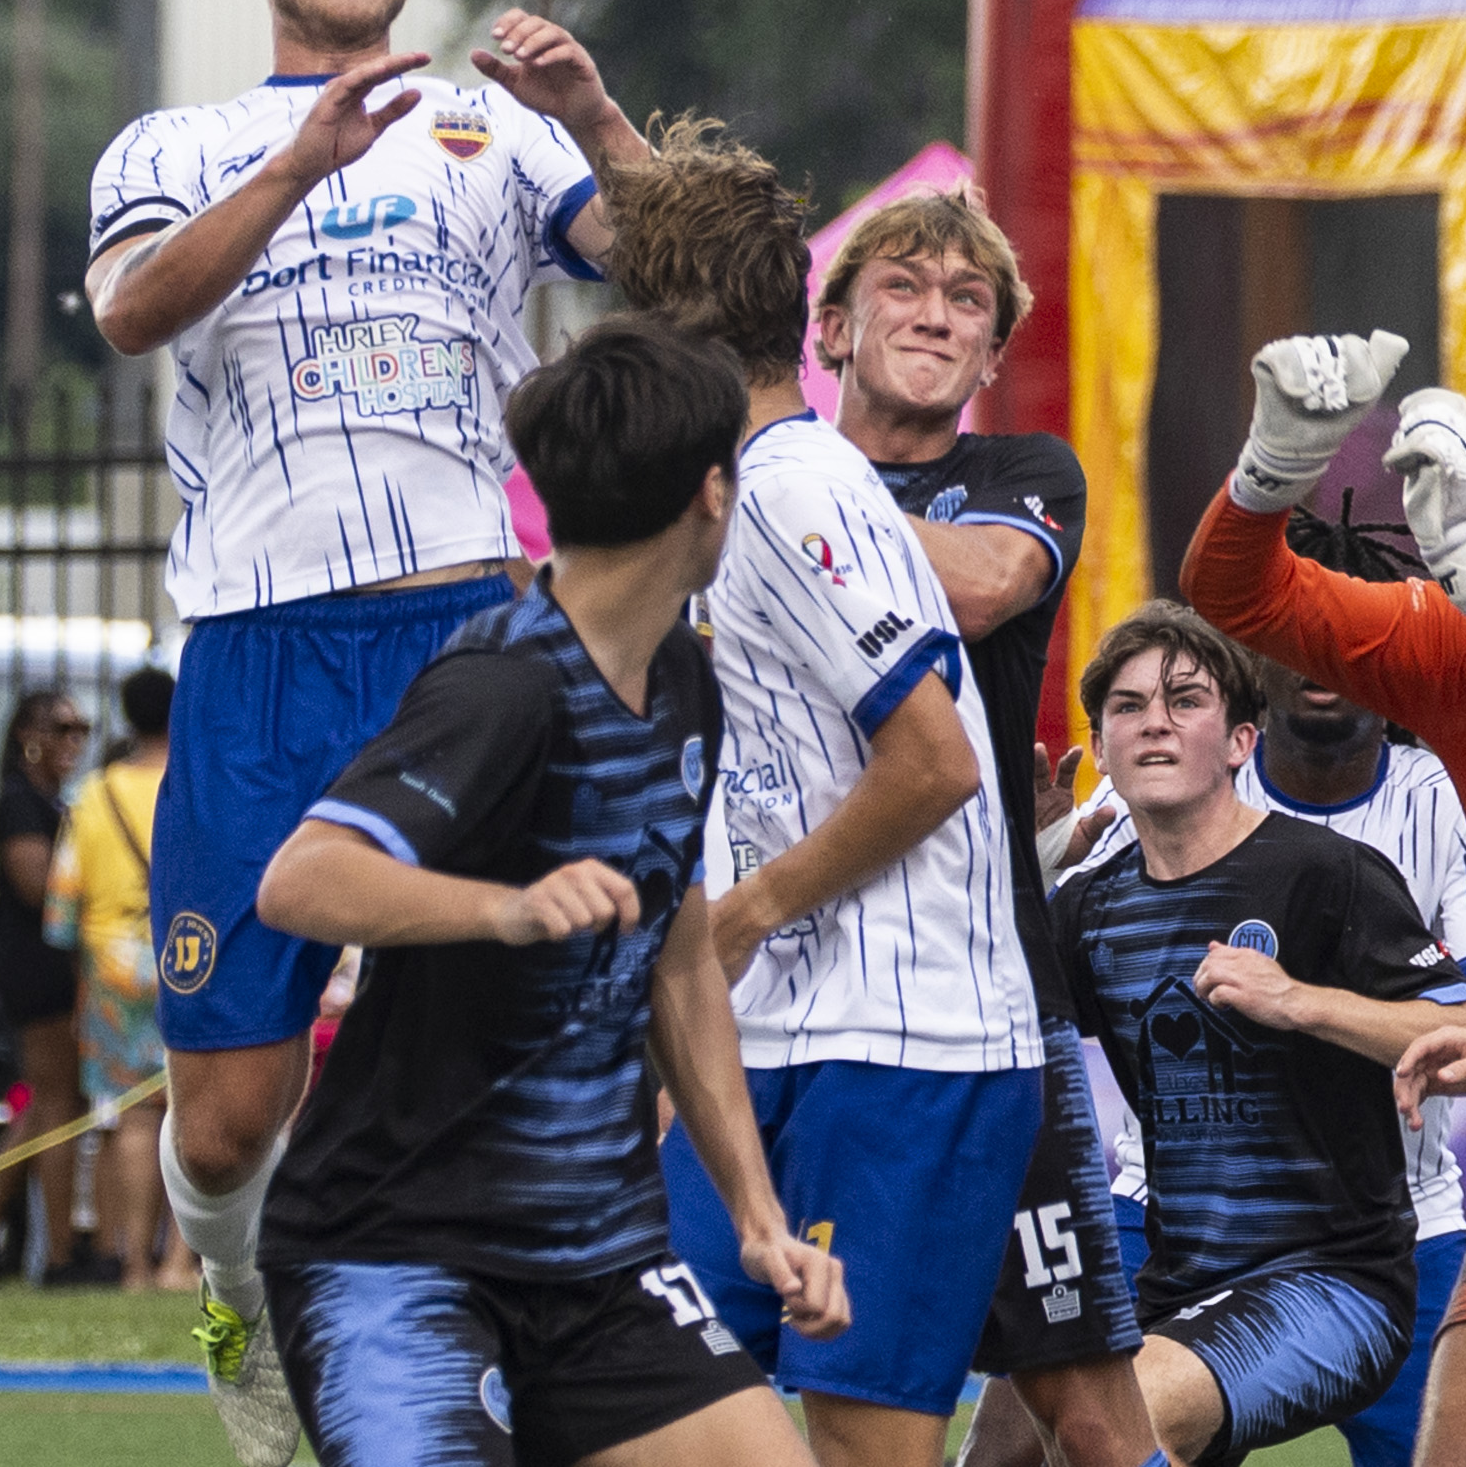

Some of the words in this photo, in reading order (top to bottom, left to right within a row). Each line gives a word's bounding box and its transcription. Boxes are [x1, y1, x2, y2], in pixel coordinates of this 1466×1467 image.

[241, 252, 332, 297] Dort
[347, 277, 429, 297] CREDIT
[319, 316, 416, 356] HURLEY
[360, 380, 467, 412] HOSPITAL
[855, 610, 915, 659] USL
[1408, 943, 1446, 968] USL
[1013, 1200, 1083, 1289] 15
[639, 1263, 718, 1327] 17
